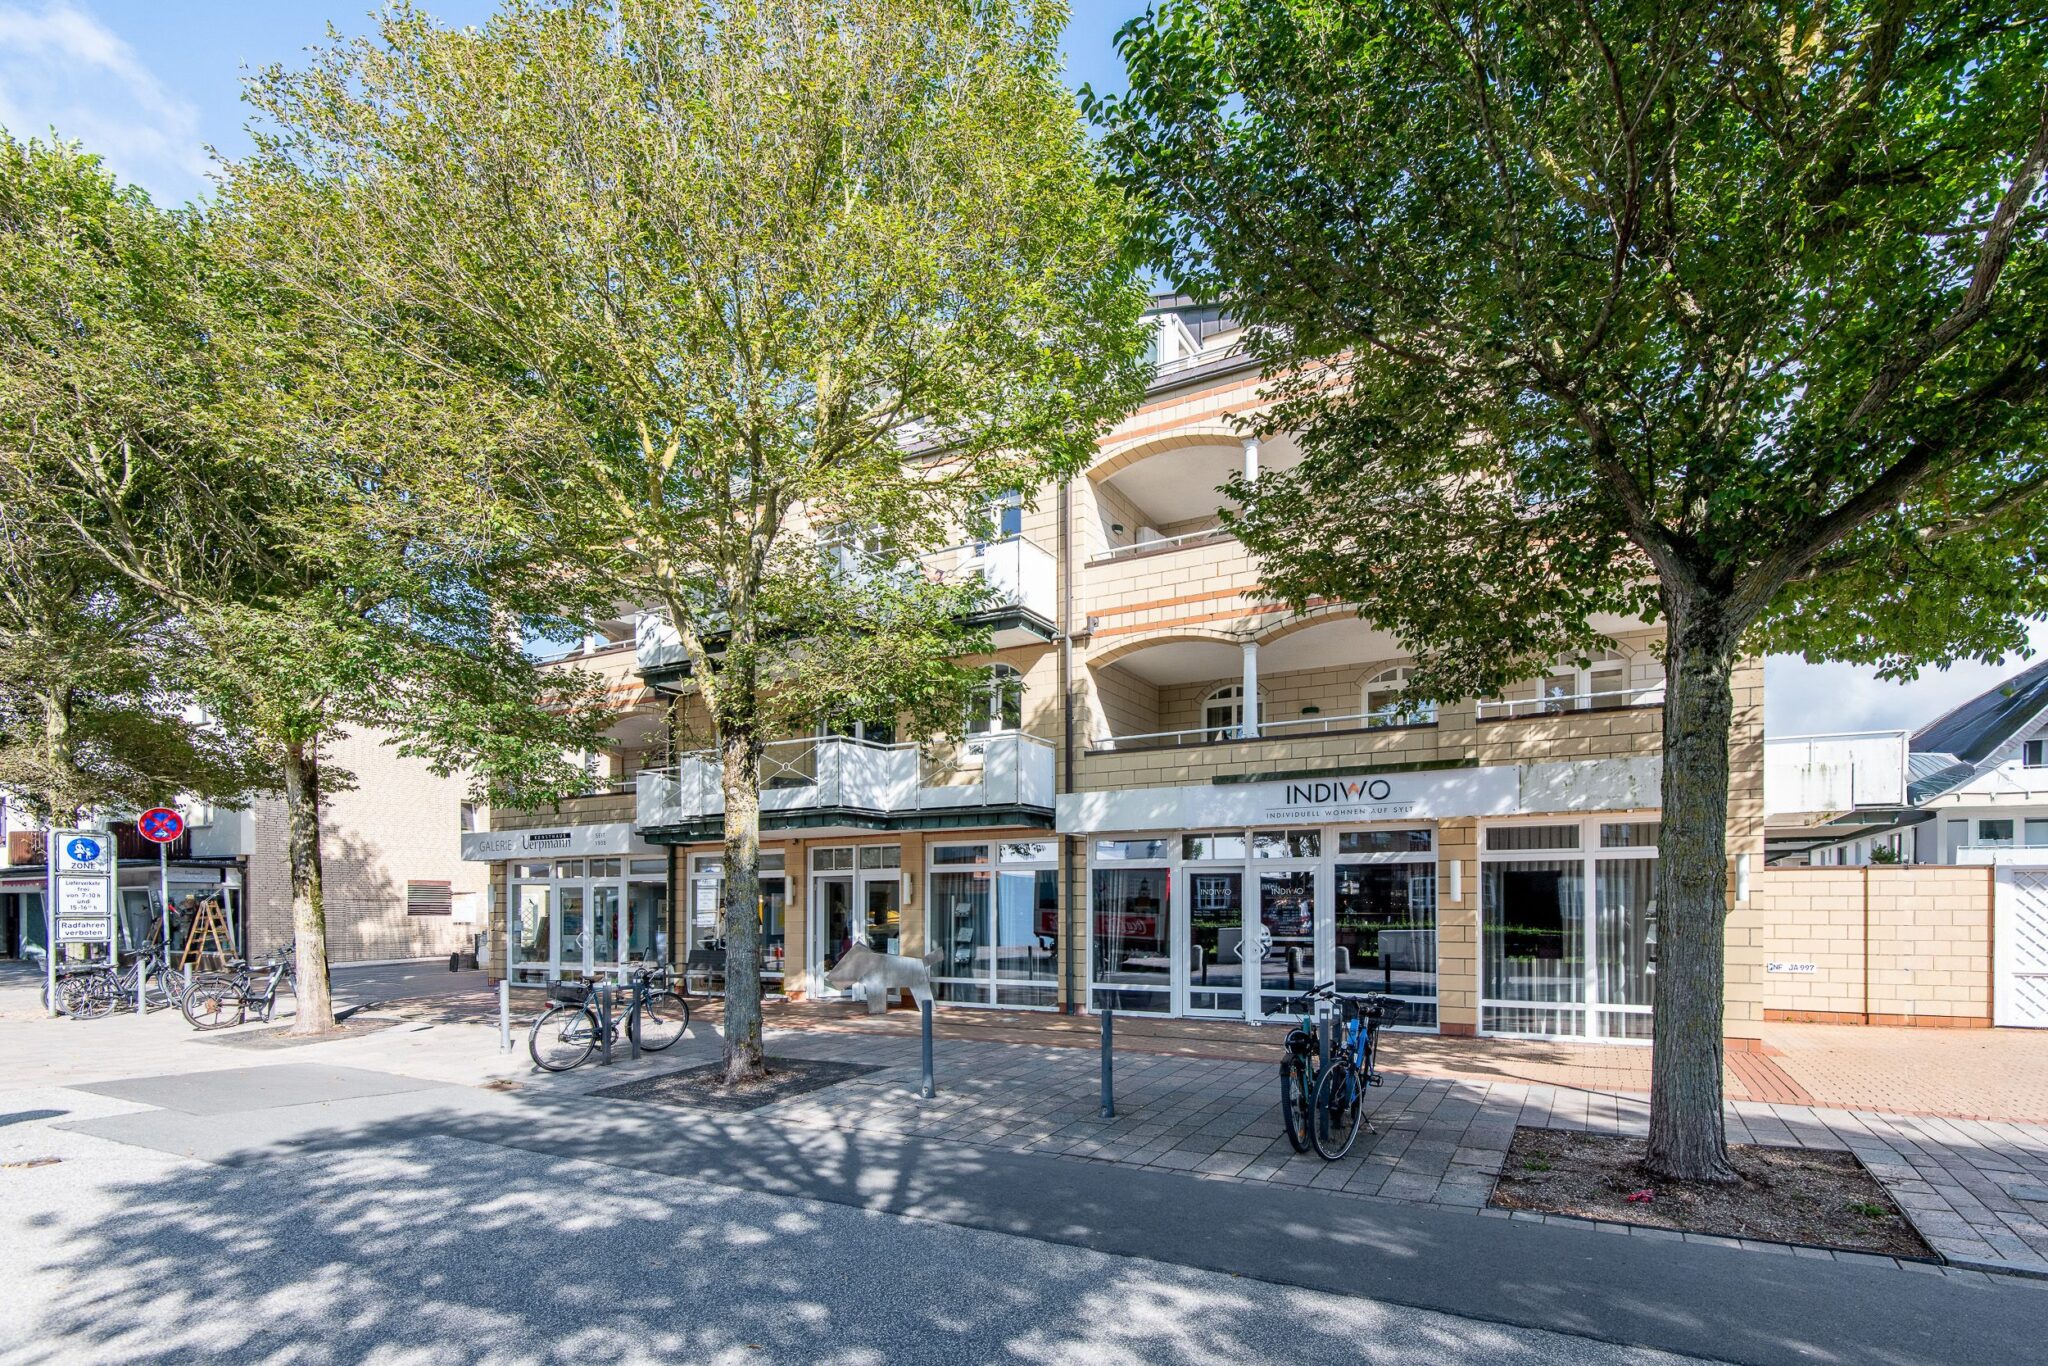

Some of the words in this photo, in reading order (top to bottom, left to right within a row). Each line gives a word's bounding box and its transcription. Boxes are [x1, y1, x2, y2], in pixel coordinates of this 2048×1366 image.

[1287, 779, 1391, 804] INDIWO
[1266, 809, 1320, 819] INDIVIDUELL
[1324, 807, 1366, 816] WOHNEN
[1370, 806, 1388, 814] AUF
[1393, 804, 1414, 813] SYLT
[479, 840, 512, 852] GALERIE
[522, 834, 571, 851] Uerpmann
